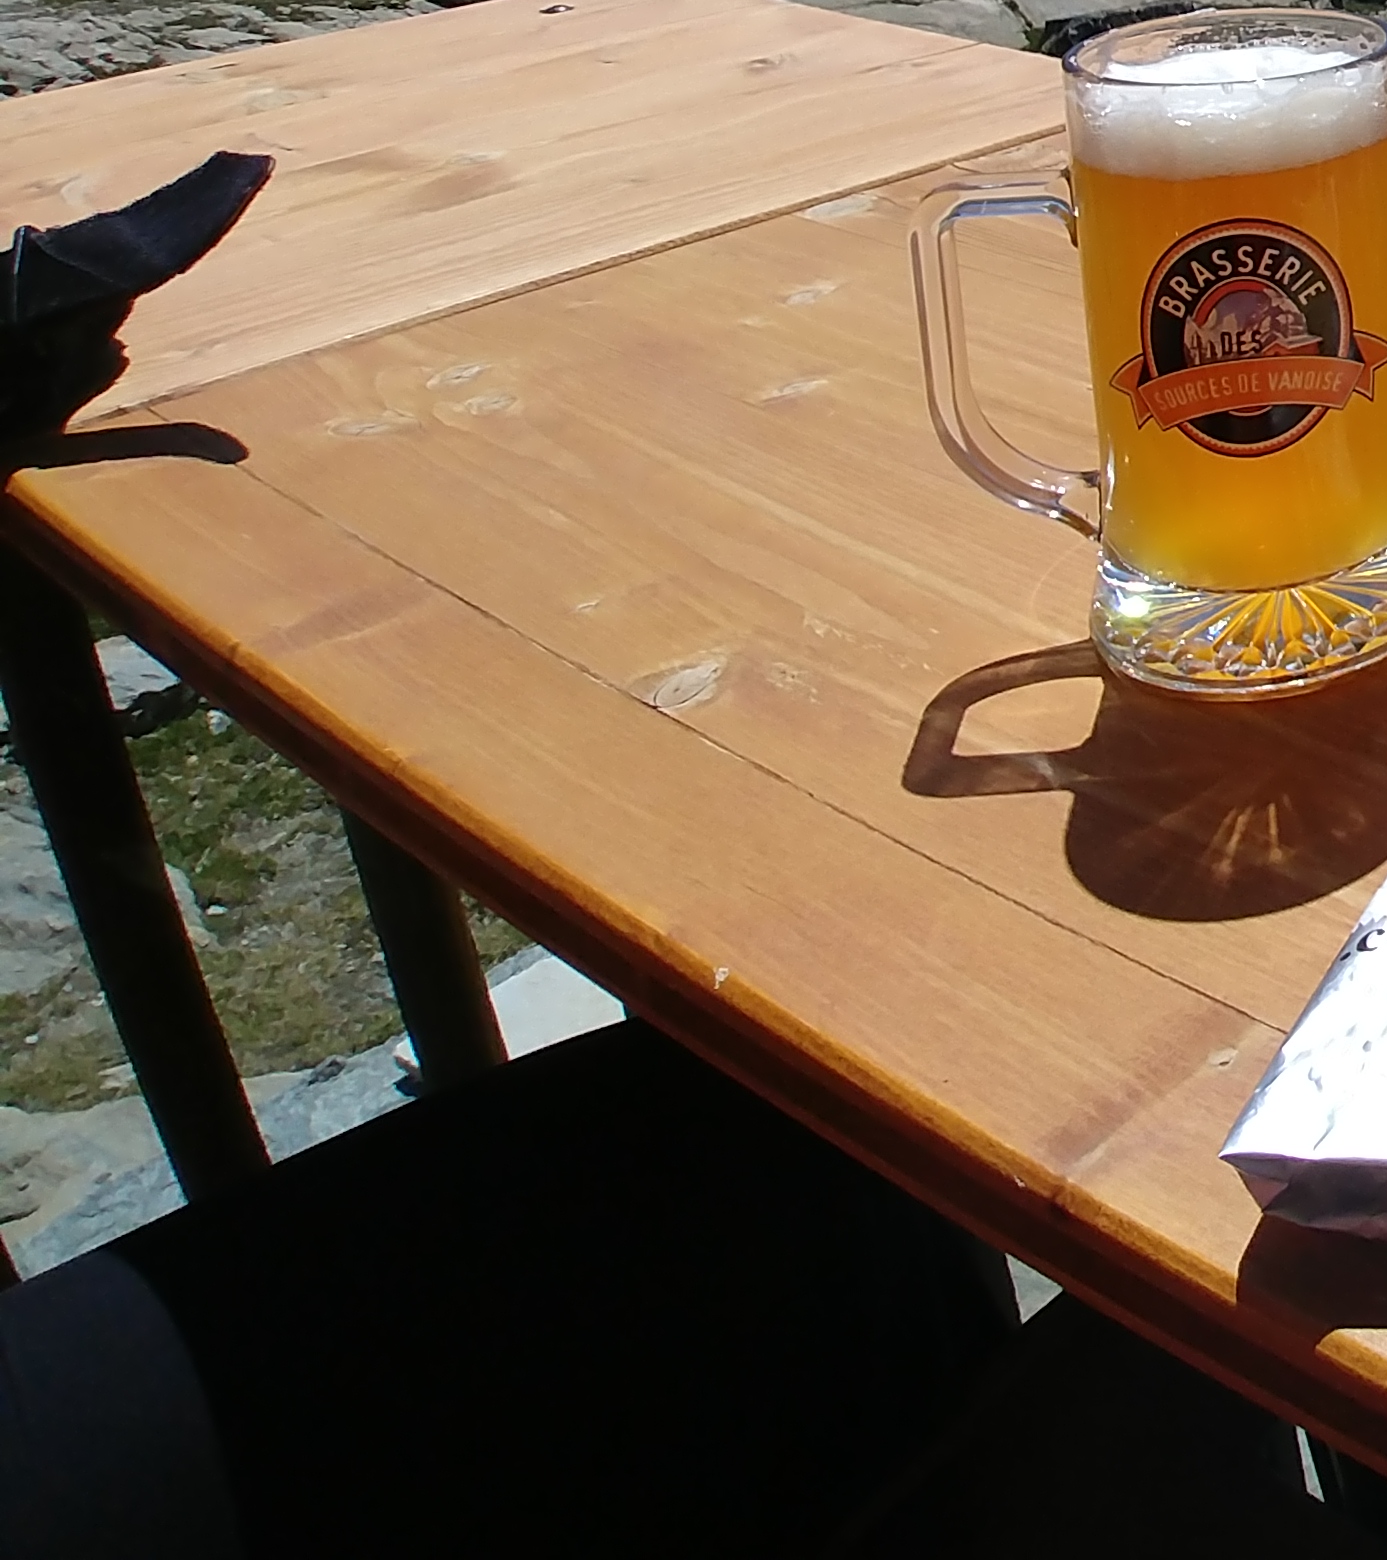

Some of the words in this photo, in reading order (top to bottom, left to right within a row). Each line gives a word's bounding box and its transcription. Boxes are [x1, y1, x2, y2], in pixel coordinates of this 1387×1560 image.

[1157, 245, 1327, 319] BRASSERIE
[1221, 331, 1264, 355] DES
[1154, 373, 1234, 411] SOURCES
[1238, 373, 1261, 393] DE
[1268, 370, 1345, 391] VANOISE
